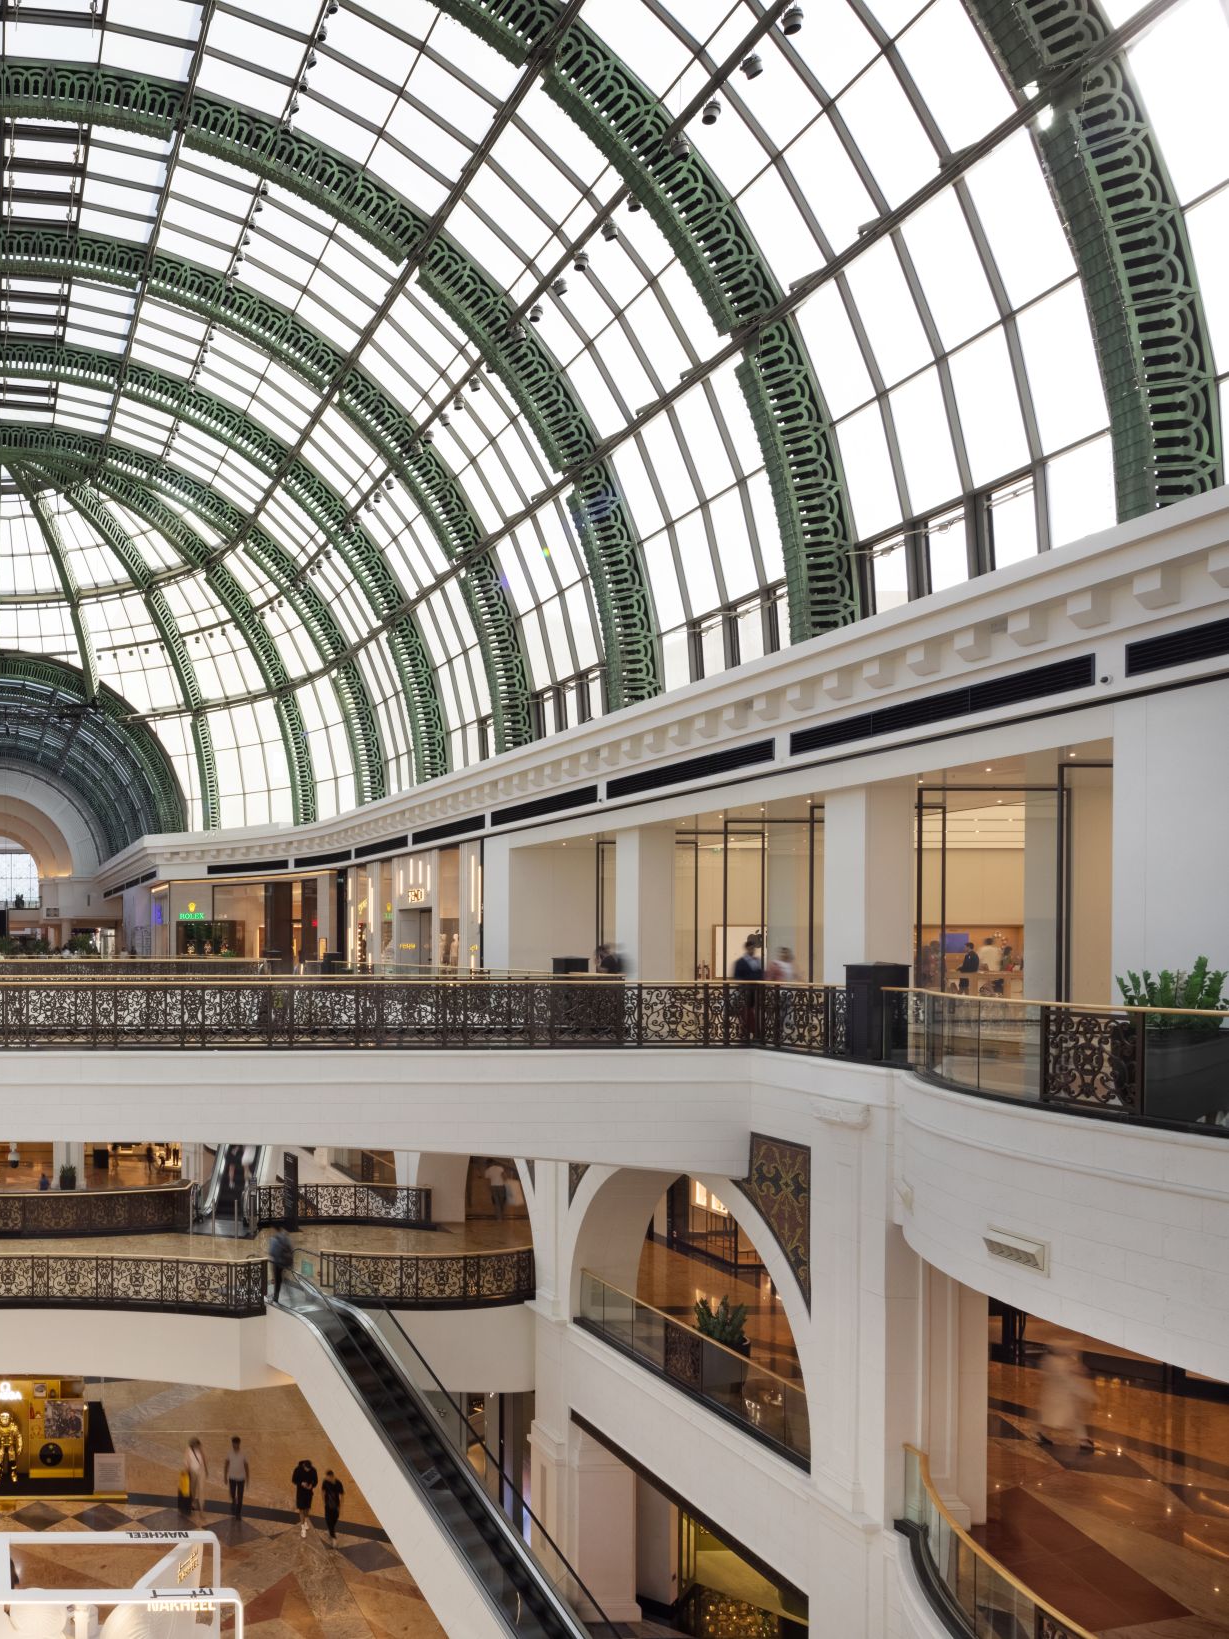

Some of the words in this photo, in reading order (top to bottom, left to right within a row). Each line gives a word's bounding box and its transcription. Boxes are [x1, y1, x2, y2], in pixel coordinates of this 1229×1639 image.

[179, 912, 205, 920] ROLEX
[125, 1531, 189, 1539] NAKHEEL
[147, 1600, 216, 1612] NAKHEEL
